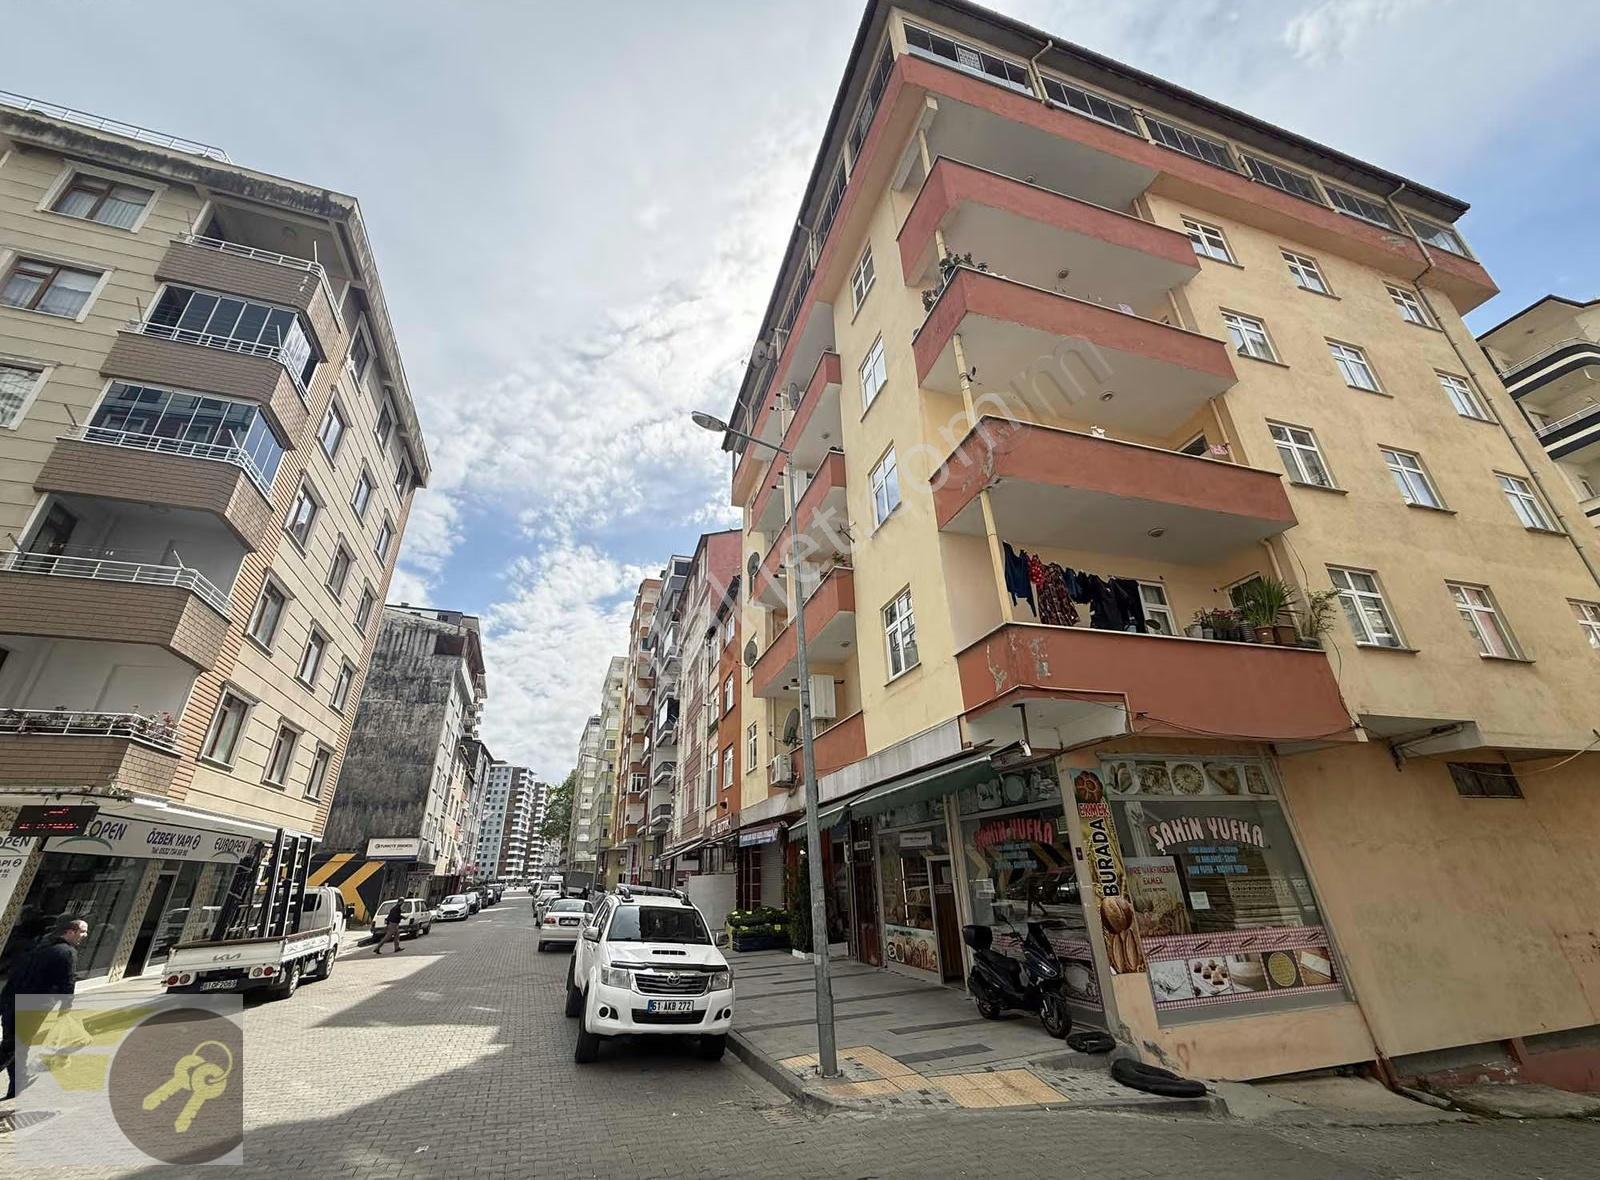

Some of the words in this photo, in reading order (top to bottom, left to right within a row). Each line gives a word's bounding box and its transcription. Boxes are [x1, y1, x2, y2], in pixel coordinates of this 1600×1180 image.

[146, 827, 177, 845] ÖZBEK
[175, 833, 194, 848] YAPI
[1206, 817, 1264, 848] YUFKA
[1089, 818, 1120, 897] BURADA
[663, 1001, 677, 1011] AKB
[678, 1001, 691, 1011] 272
